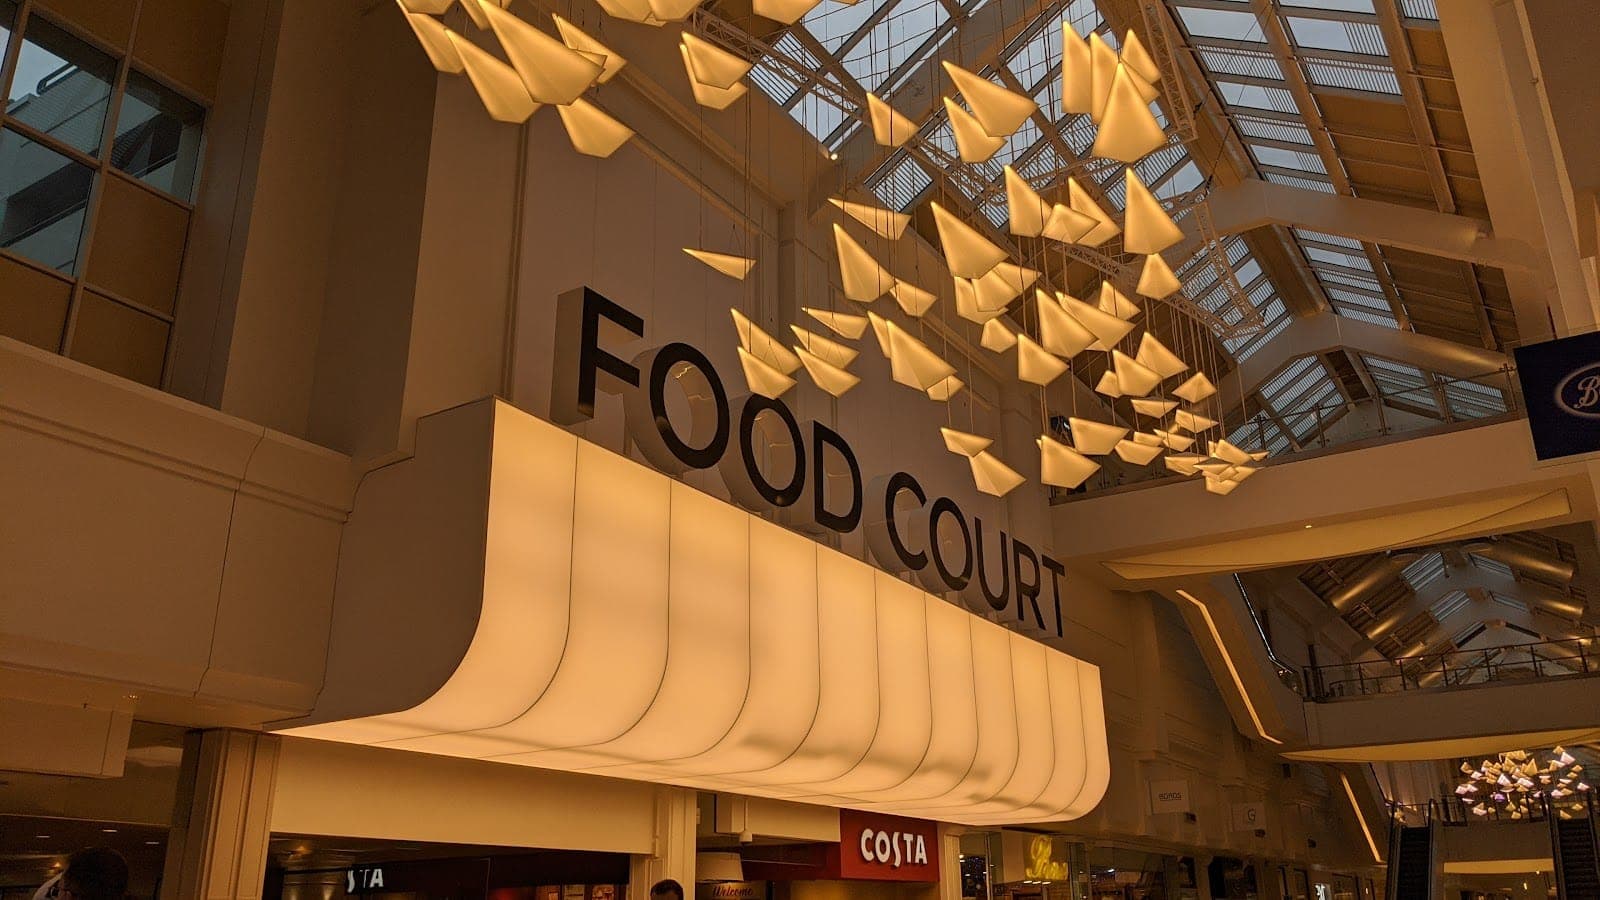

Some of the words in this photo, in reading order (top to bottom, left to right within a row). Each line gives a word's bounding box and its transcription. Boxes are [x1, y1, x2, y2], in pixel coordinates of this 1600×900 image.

[577, 286, 863, 534] FOOD
[885, 471, 1066, 638] COURT
[861, 828, 928, 868] COSTA
